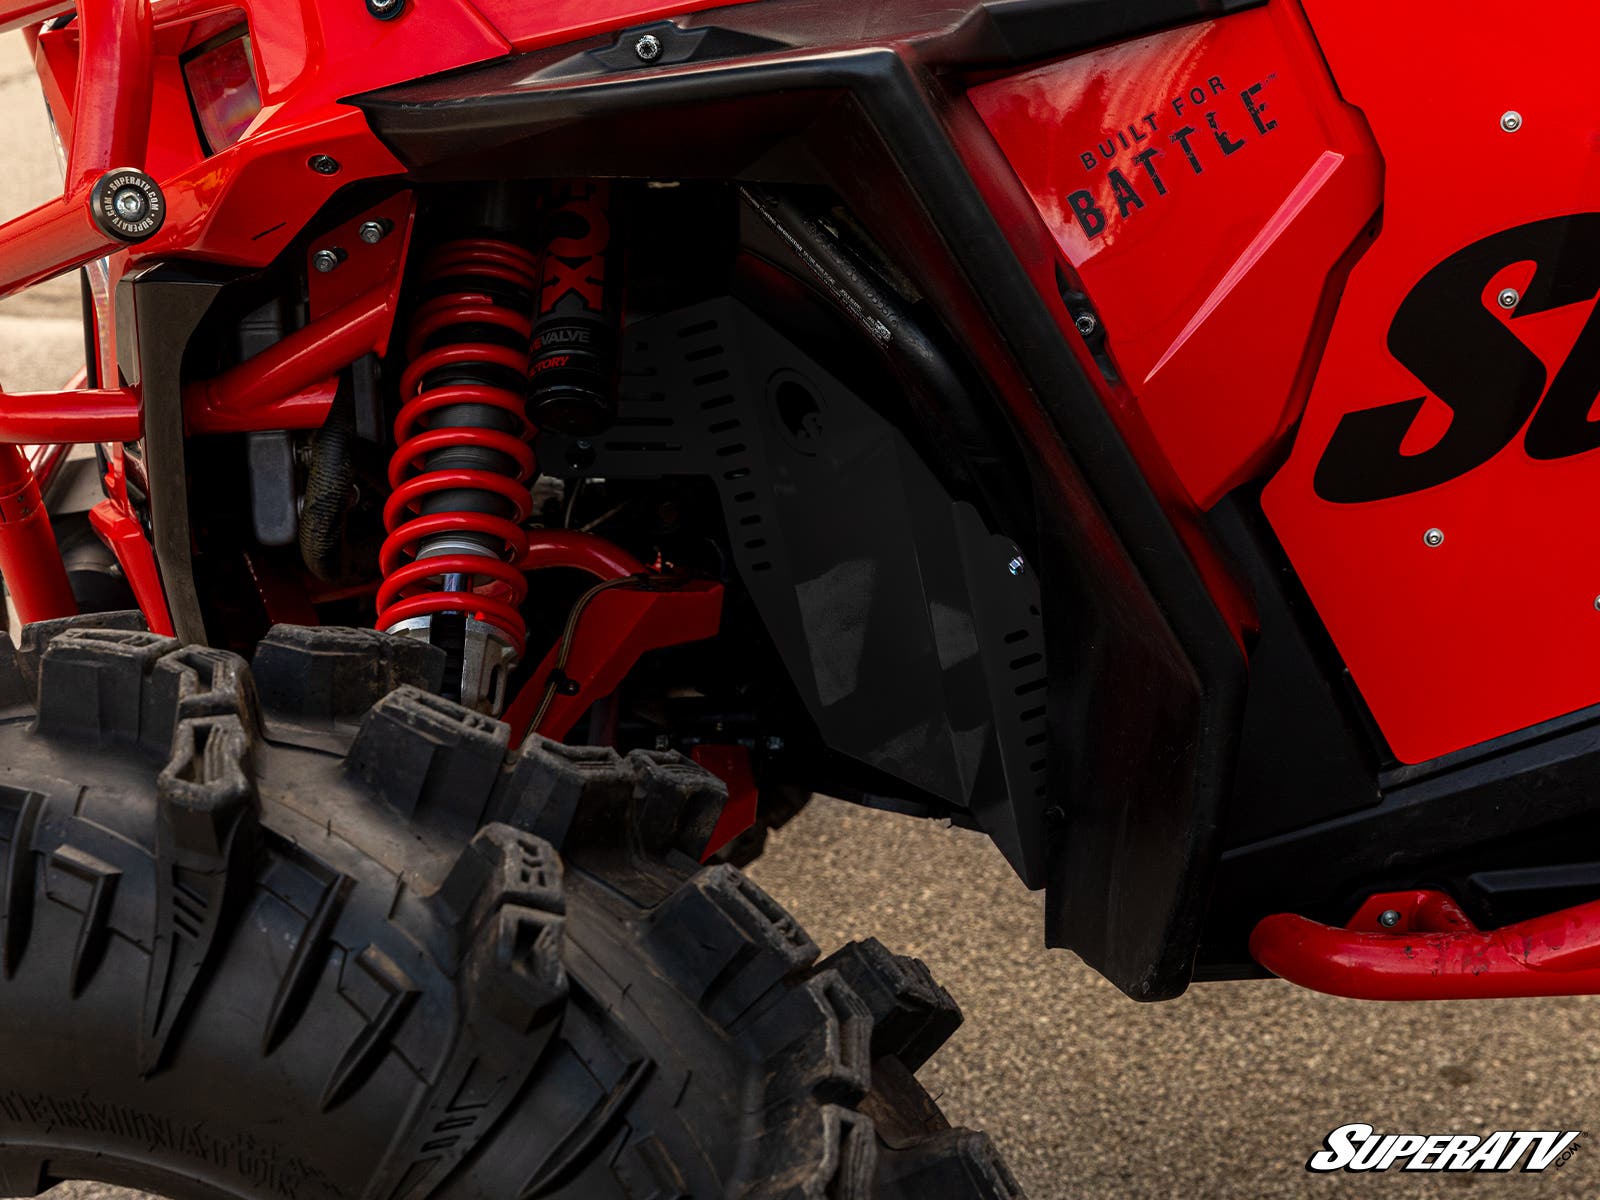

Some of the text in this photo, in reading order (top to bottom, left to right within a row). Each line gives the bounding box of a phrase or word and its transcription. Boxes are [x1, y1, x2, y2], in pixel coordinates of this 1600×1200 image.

[1079, 75, 1227, 171] BUILT FOR
[108, 176, 159, 211] SUPERATV.COM
[1065, 83, 1279, 241] BATTLE
[104, 194, 154, 233] SUPERATV.COM
